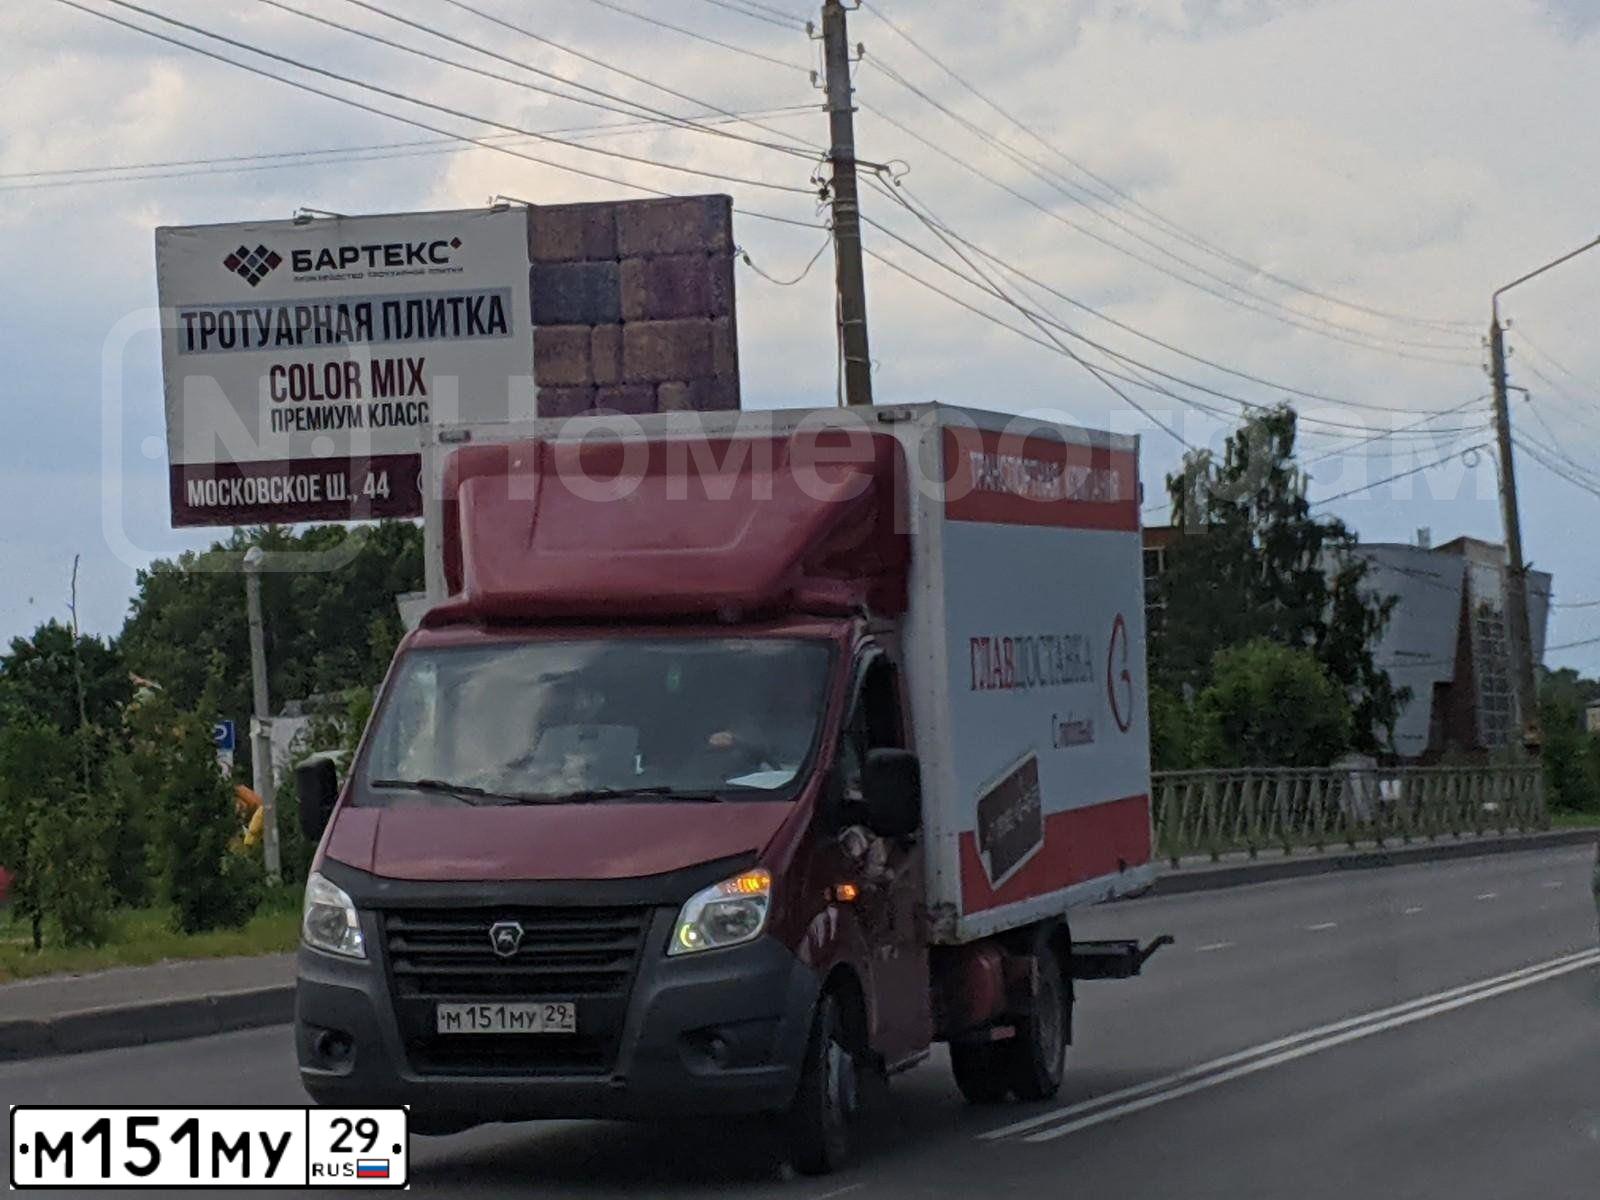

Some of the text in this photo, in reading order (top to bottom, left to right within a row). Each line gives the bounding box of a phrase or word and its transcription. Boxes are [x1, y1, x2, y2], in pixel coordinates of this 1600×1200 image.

[291, 240, 449, 273] БАРТЕКС
[181, 295, 508, 351] ТРОТУАРНАЯ ПЛИТКА
[269, 356, 428, 403] COLOR MIX
[270, 401, 429, 433] ПРЕМИУМ КЛАСС
[187, 474, 321, 508] МОСКОВСКОЕ
[362, 470, 391, 500] 44
